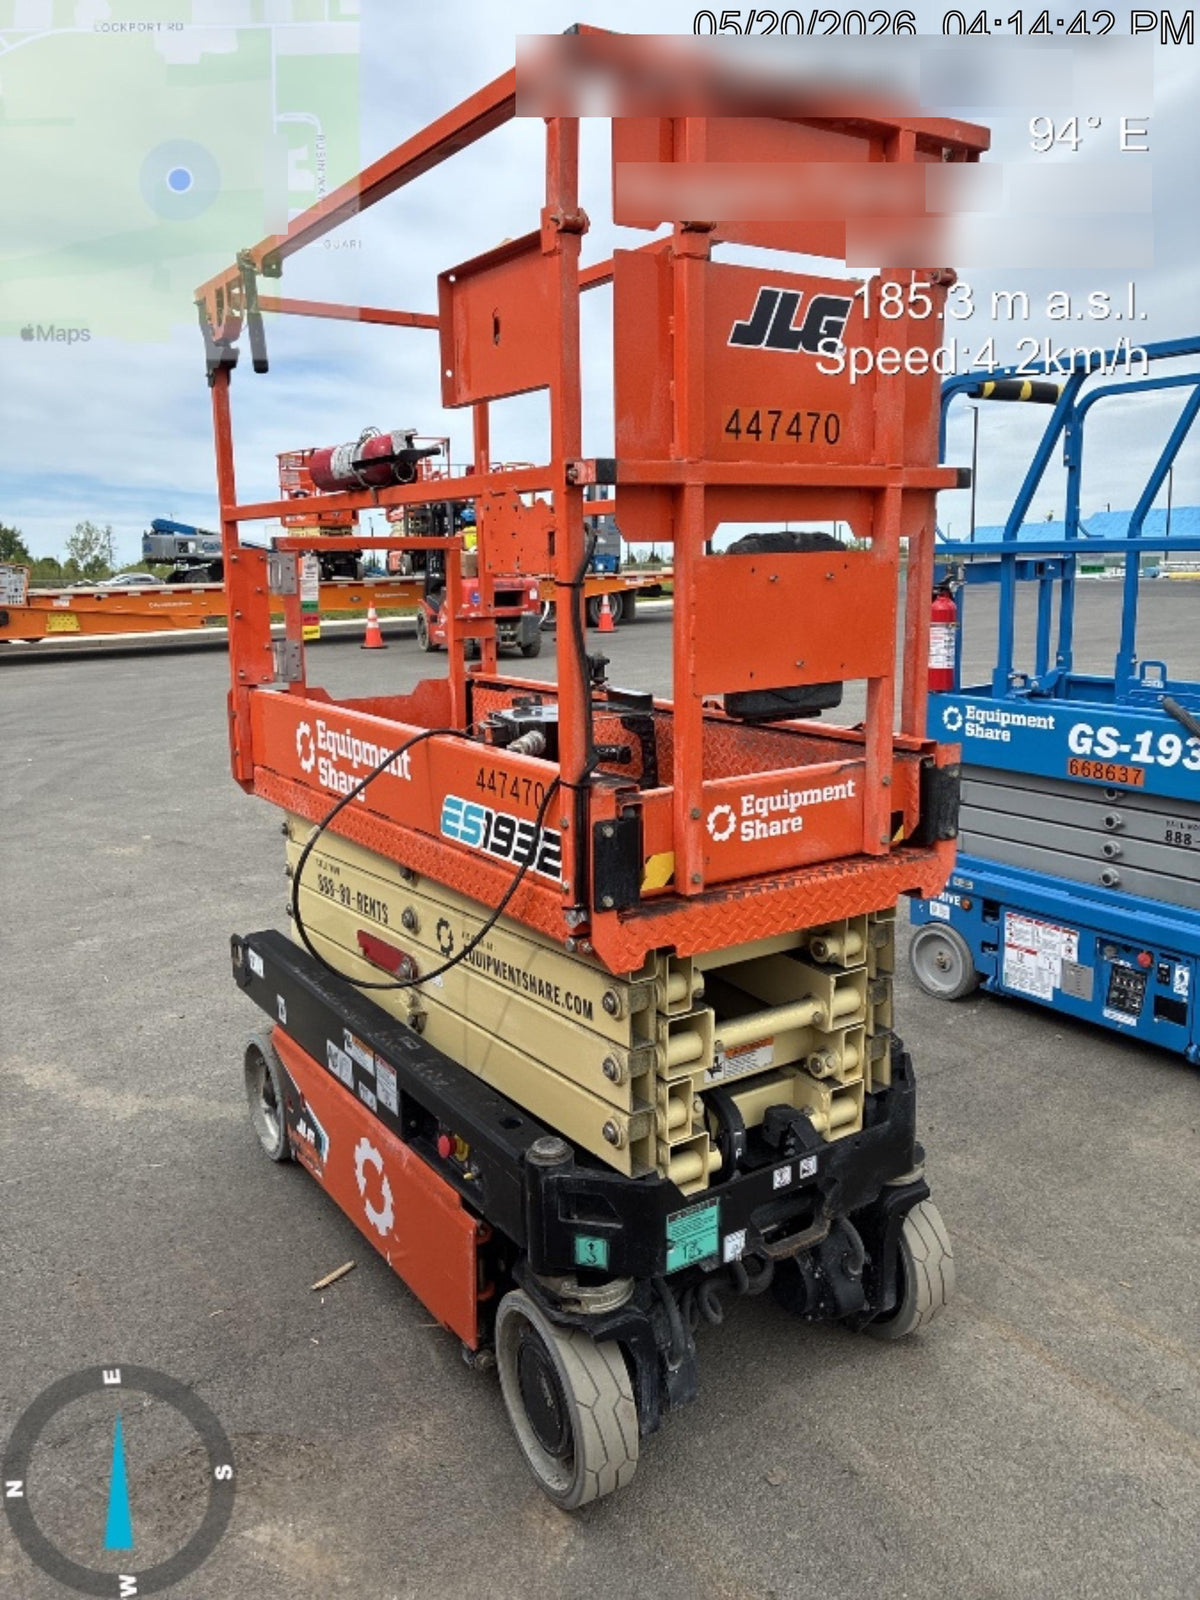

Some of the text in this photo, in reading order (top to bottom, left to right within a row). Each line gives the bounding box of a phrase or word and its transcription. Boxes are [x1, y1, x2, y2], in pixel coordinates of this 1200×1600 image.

[727, 285, 854, 356] JLG
[725, 409, 840, 444] 447470
[965, 705, 1055, 730] Equipment
[965, 723, 1011, 742] Share
[316, 719, 411, 781] Equipment
[318, 756, 366, 802] Share
[476, 767, 545, 810] 447470
[1069, 758, 1143, 785] 668637
[740, 779, 855, 818] Equipment
[441, 795, 562, 882] ES1932
[740, 815, 803, 842] Share
